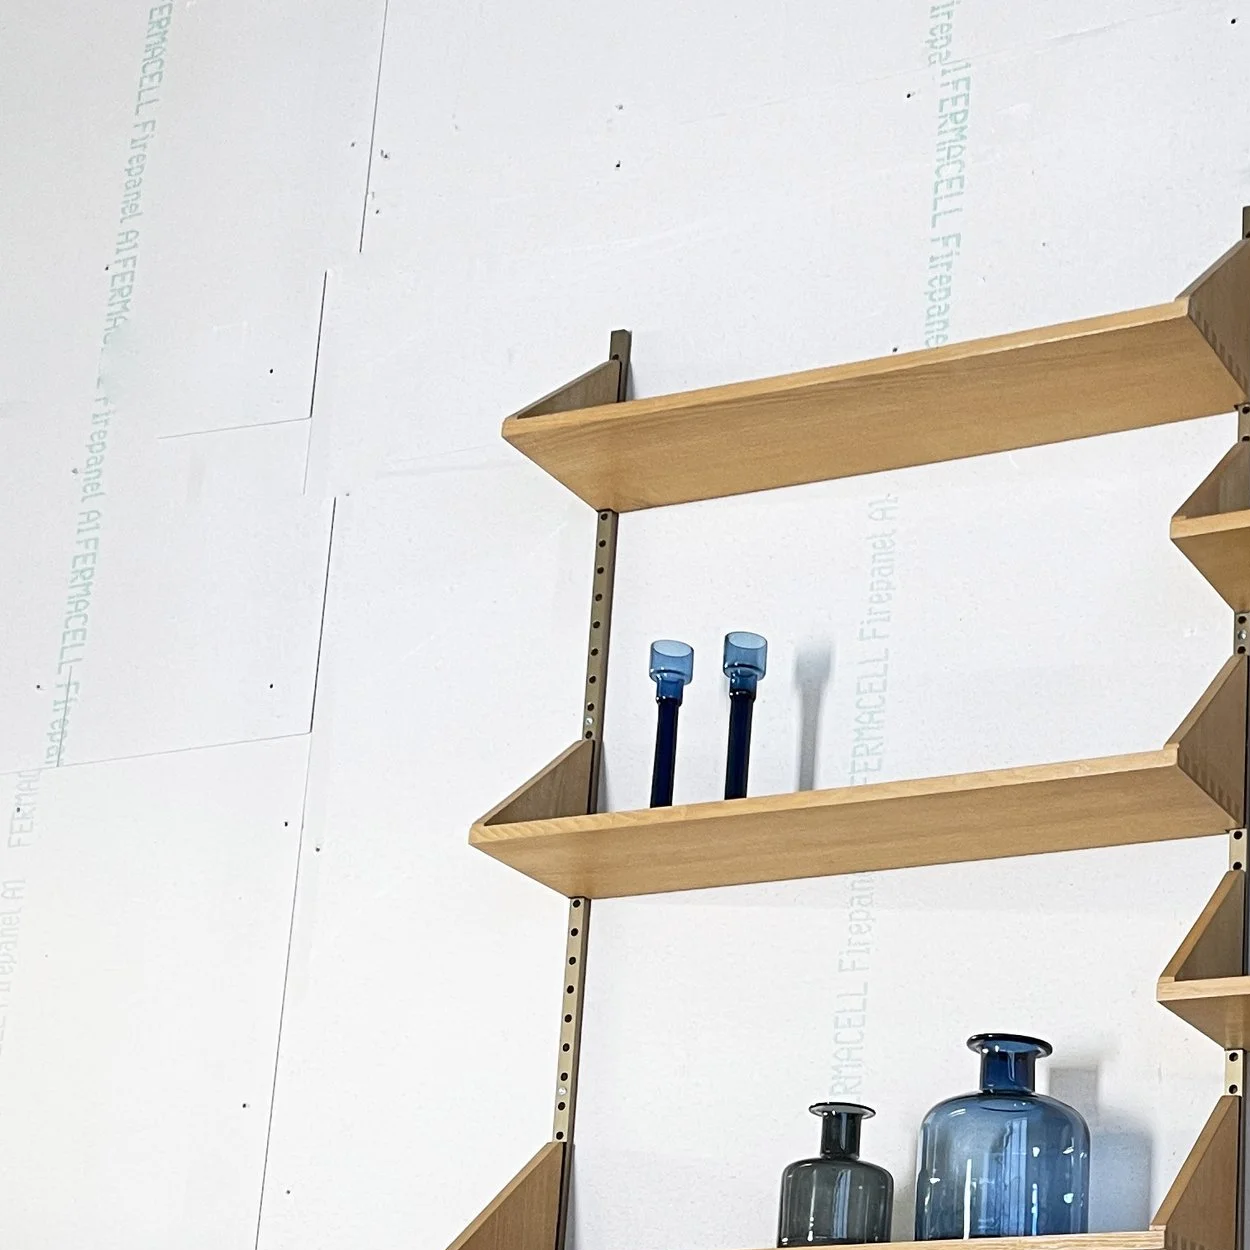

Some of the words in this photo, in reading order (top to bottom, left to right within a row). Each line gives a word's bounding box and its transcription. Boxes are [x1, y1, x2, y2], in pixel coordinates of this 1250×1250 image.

[136, 0, 174, 116] ERMACELL
[120, 118, 158, 223] Firepanel
[924, 232, 962, 348] Firepane
[857, 529, 897, 642] Firepanel
[837, 876, 876, 973] Firepan
[829, 982, 869, 1101] RMACELL
